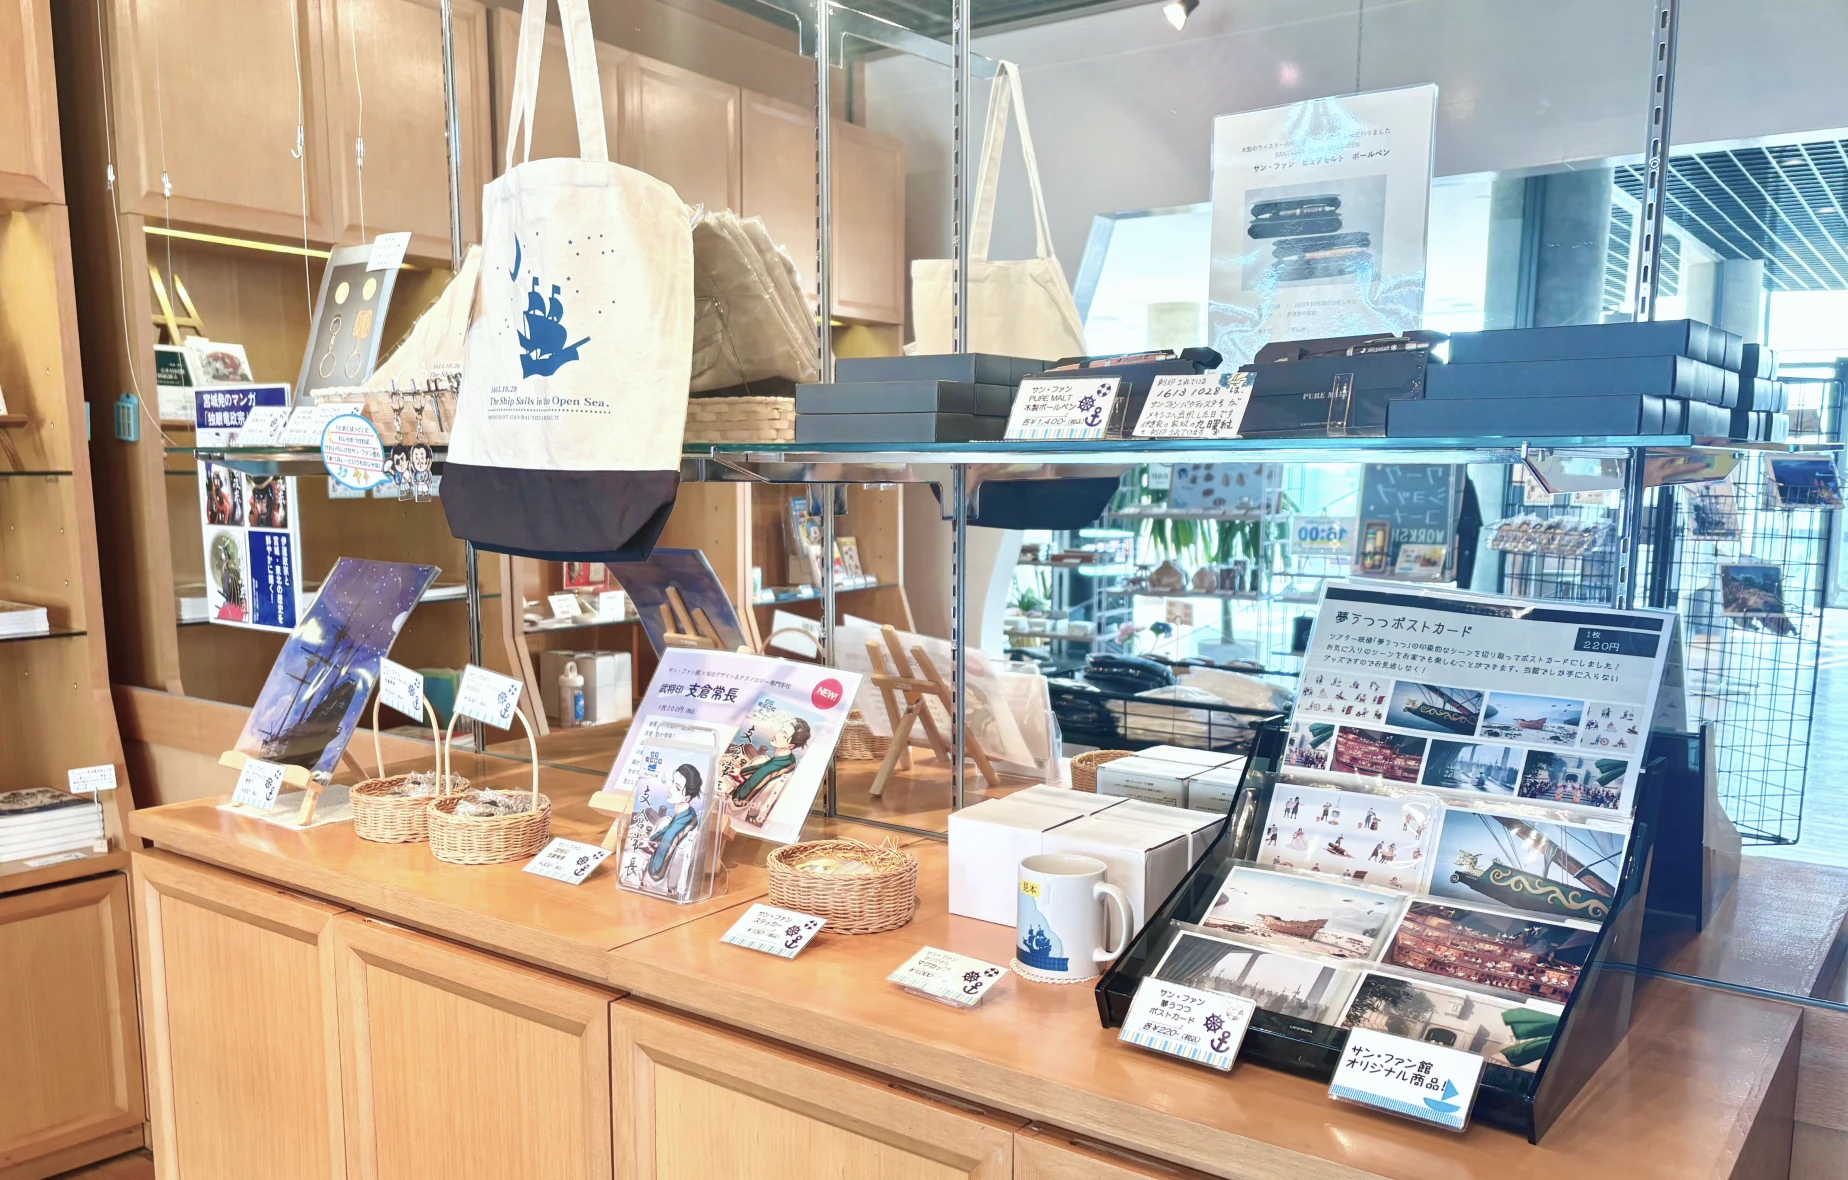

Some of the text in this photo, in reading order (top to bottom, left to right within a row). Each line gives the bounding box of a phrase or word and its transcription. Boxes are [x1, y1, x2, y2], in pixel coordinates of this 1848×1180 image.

[1253, 161, 1295, 172] サン・ファン
[1352, 149, 1391, 160] ボールペン
[1157, 377, 1207, 387] 刻印されている
[1032, 385, 1073, 394] サン・ファン
[1156, 388, 1187, 398] 1613
[1190, 386, 1221, 396] 1028
[1303, 392, 1326, 400] PURE
[203, 391, 257, 409] 宮城発のマンガ
[490, 397, 499, 406] The
[499, 396, 515, 407] Ship
[516, 396, 535, 406] Sails
[536, 396, 543, 406] in
[551, 396, 580, 407] Open
[584, 397, 610, 408] Sea.
[1050, 394, 1073, 402] MALT
[1024, 403, 1077, 412] 木製ボールペン
[1335, 610, 1473, 638] 夢うつつポストカード
[1586, 630, 1601, 639] 1枚
[1583, 640, 1621, 652] 220円
[658, 682, 740, 703] 武将印 支倉常長
[816, 686, 838, 702] NEW!
[624, 784, 652, 878] 支倉常長
[1022, 881, 1038, 895] 見本
[753, 917, 783, 927] ステッカー
[757, 911, 793, 923] サン・ファン
[1160, 988, 1206, 1006] サン・ファン
[1160, 999, 1192, 1013] 夢うつつ
[1149, 1007, 1196, 1024] ポストカード
[1351, 1045, 1434, 1075] サン・ファン館
